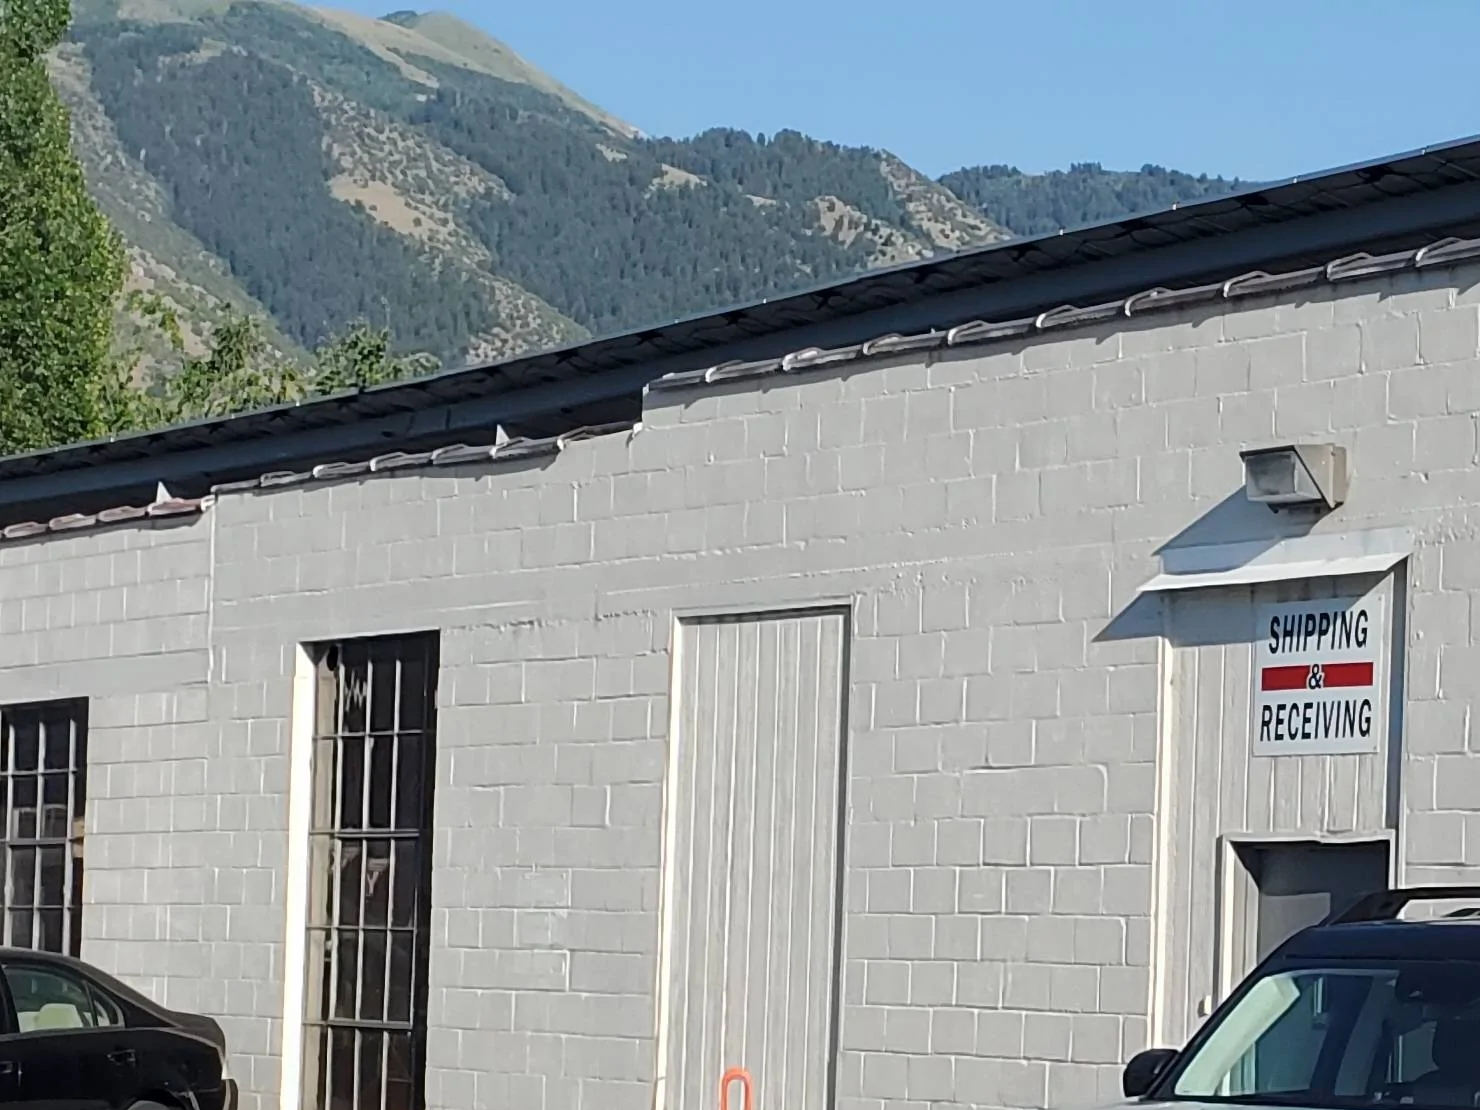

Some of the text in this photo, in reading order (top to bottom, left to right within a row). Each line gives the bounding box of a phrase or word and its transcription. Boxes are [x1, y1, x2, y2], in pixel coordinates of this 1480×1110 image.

[1269, 609, 1369, 654] SHIPPING
[1308, 663, 1323, 690] &
[1260, 699, 1372, 742] RECEIVING
